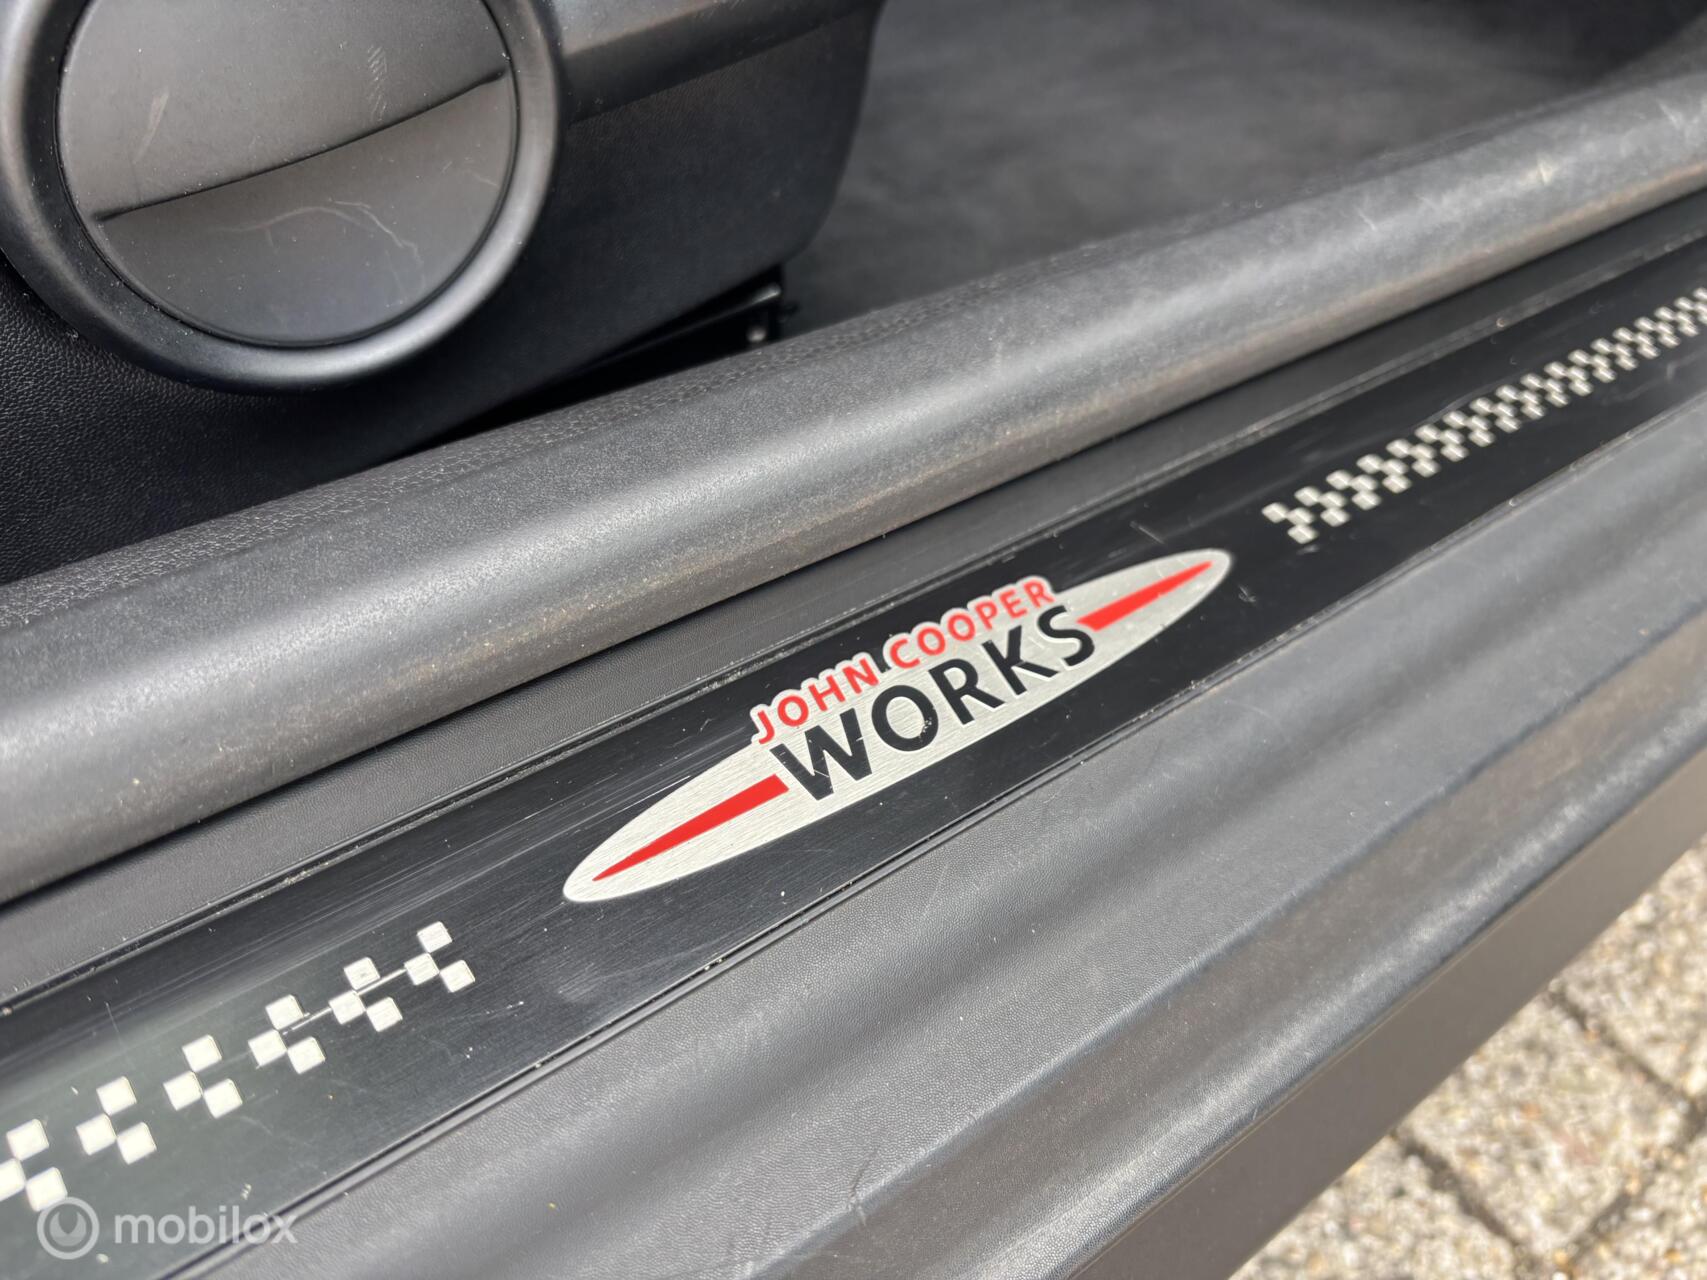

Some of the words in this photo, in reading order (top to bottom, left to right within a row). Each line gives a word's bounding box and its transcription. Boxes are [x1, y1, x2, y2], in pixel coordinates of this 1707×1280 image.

[757, 657, 879, 744] JOHN
[889, 579, 1055, 669] COOPER
[769, 604, 1095, 801] WORKS
